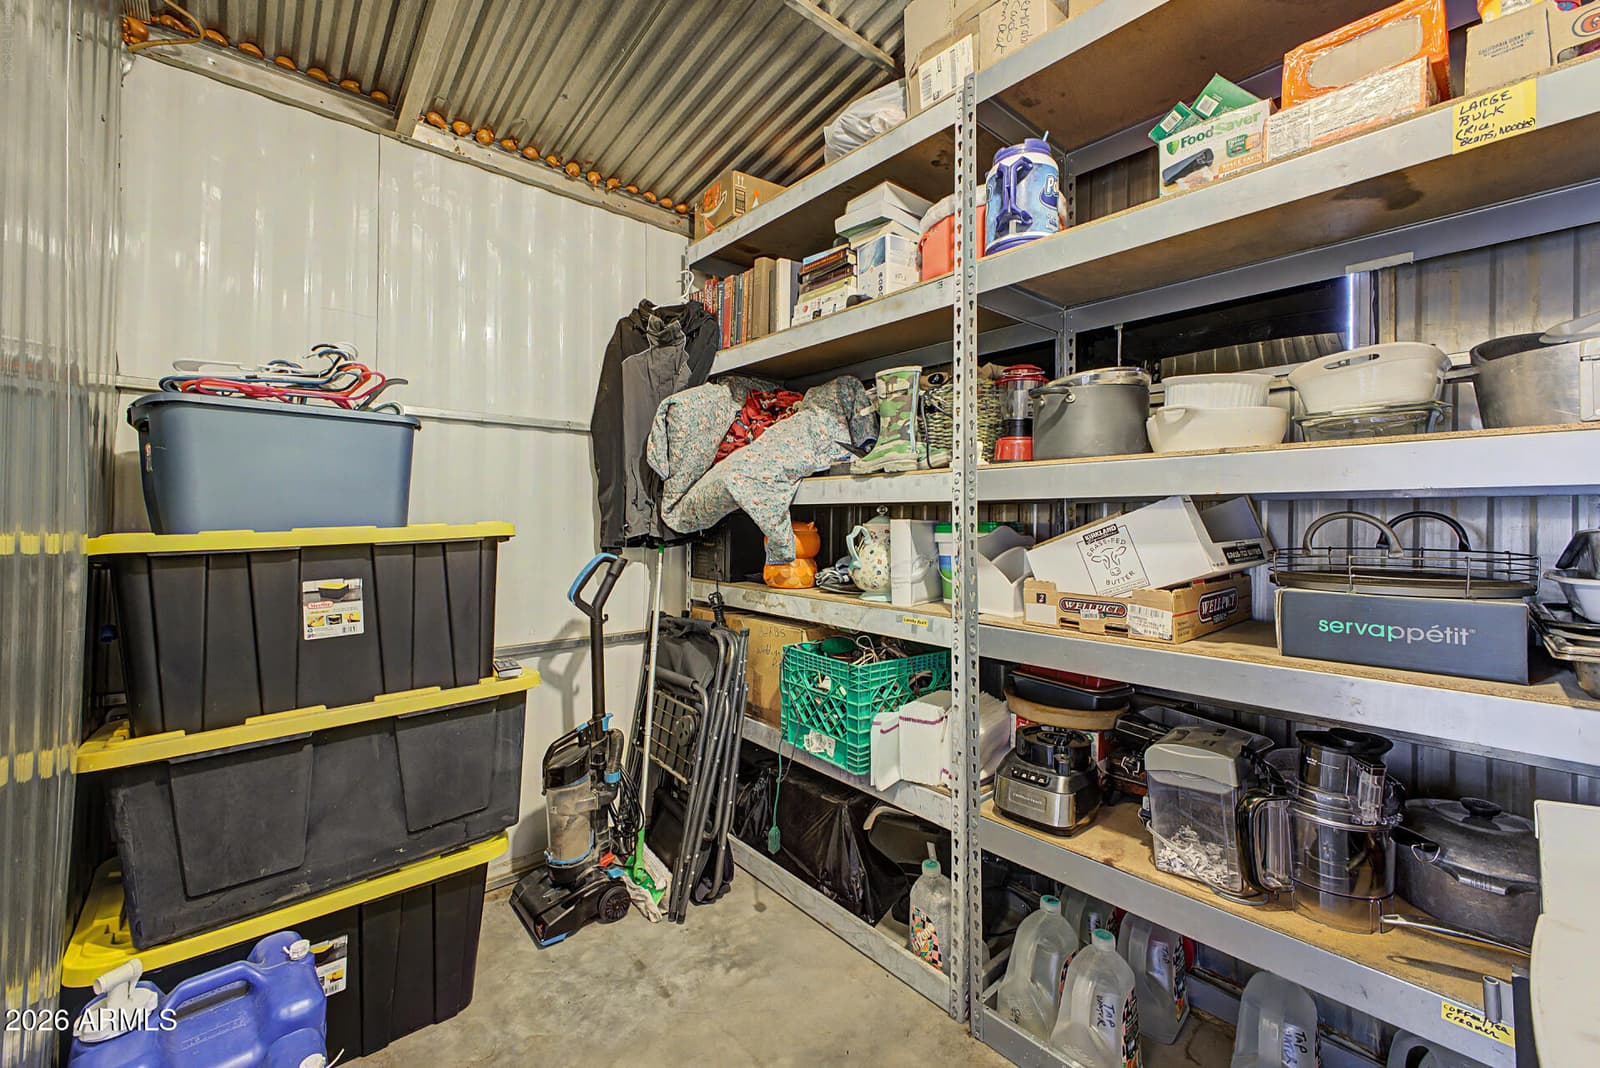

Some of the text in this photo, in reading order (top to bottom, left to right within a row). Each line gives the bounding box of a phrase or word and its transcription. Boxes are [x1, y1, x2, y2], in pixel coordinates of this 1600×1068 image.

[1460, 90, 1512, 115] LARGE
[1459, 104, 1505, 127] BULK
[1180, 111, 1261, 148] FoodSaver
[1084, 524, 1118, 541] KIRKLAND
[1105, 570, 1136, 586] BUTTER
[1318, 619, 1470, 646] servappétit
[1103, 1004, 1116, 1028] TAP
[1294, 1031, 1308, 1054] TAP
